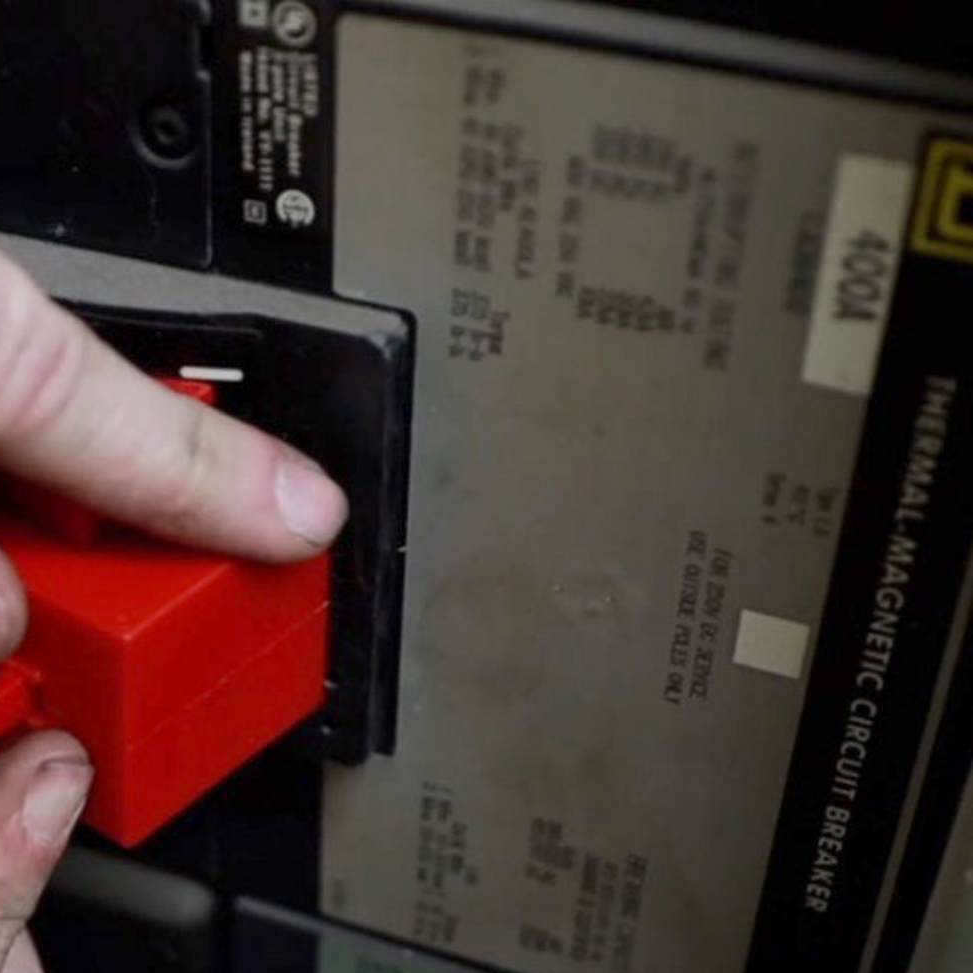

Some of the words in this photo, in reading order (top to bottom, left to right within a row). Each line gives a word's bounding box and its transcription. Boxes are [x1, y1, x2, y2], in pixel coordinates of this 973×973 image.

[832, 230, 889, 322] 400A
[710, 548, 733, 577] FOR
[831, 700, 876, 800] CIRCUIT
[804, 805, 848, 912] BREAKER
